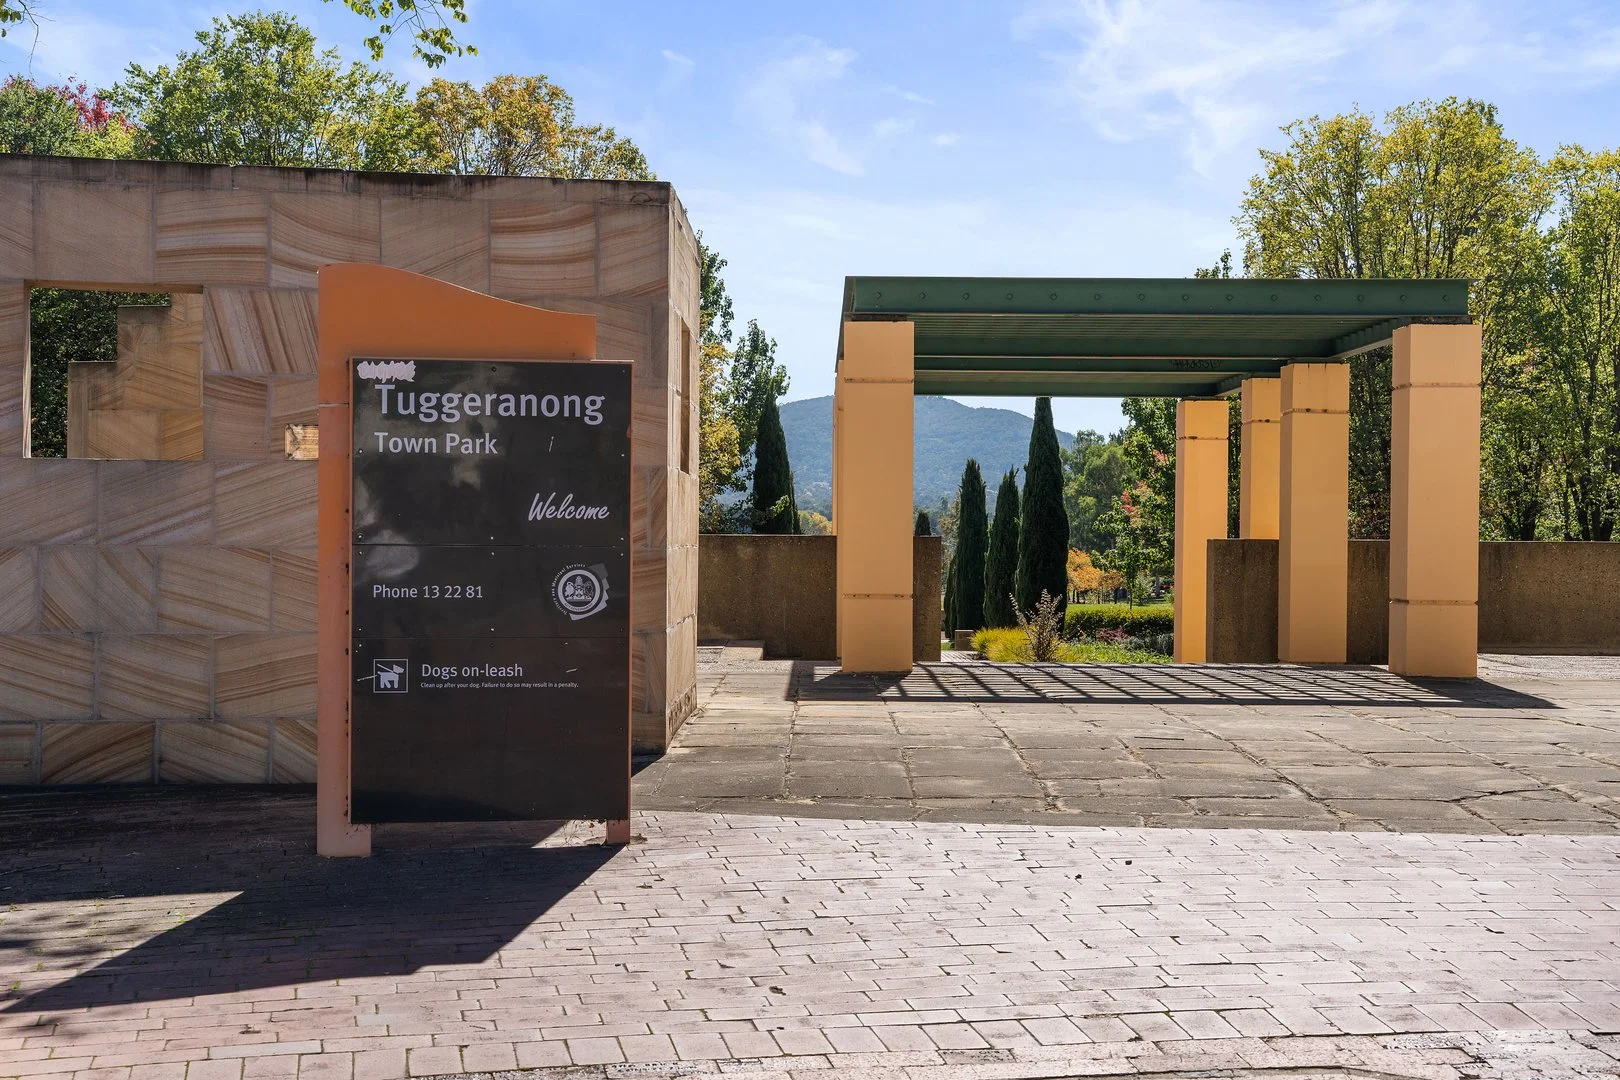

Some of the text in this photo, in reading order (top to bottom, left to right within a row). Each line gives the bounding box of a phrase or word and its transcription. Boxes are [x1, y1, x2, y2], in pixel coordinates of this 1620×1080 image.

[374, 384, 606, 425] Tuggeranong
[374, 432, 498, 454] Town Park
[528, 492, 610, 522] Welcome
[373, 584, 483, 598] Phone 13 22 81
[422, 664, 523, 679] Dogs on-leash
